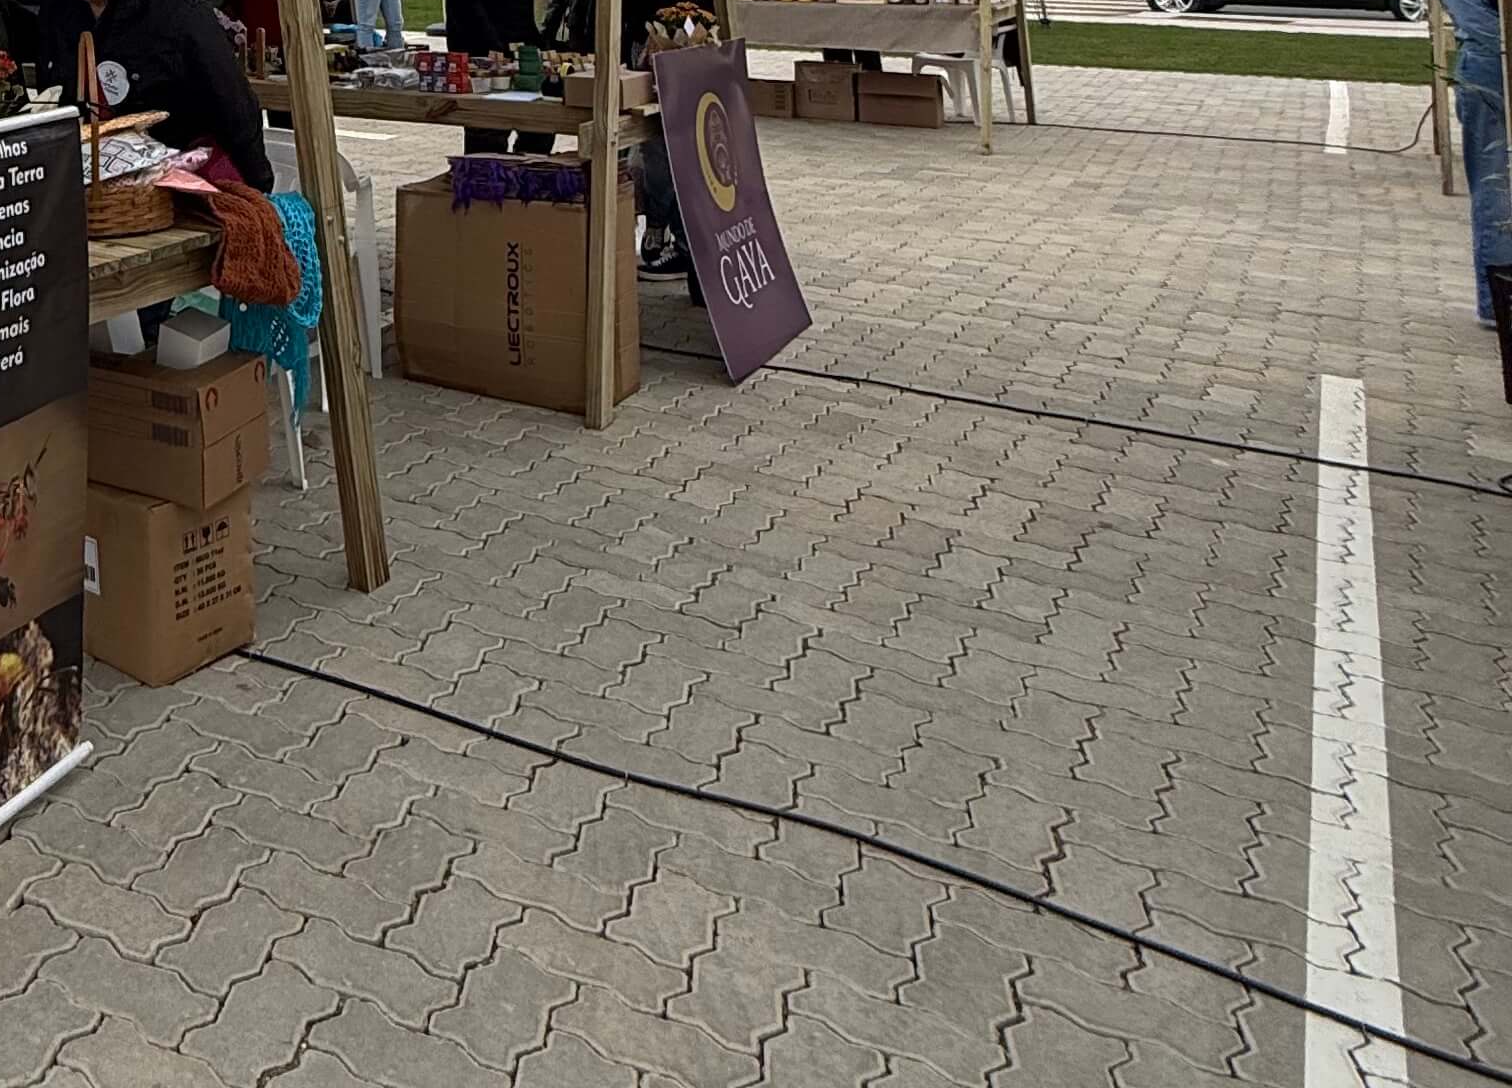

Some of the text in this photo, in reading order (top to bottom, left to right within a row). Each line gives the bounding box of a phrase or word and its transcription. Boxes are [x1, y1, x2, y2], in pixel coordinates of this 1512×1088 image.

[8, 166, 44, 186] Terra
[720, 237, 776, 309] GAYA
[1, 287, 34, 311] Flora
